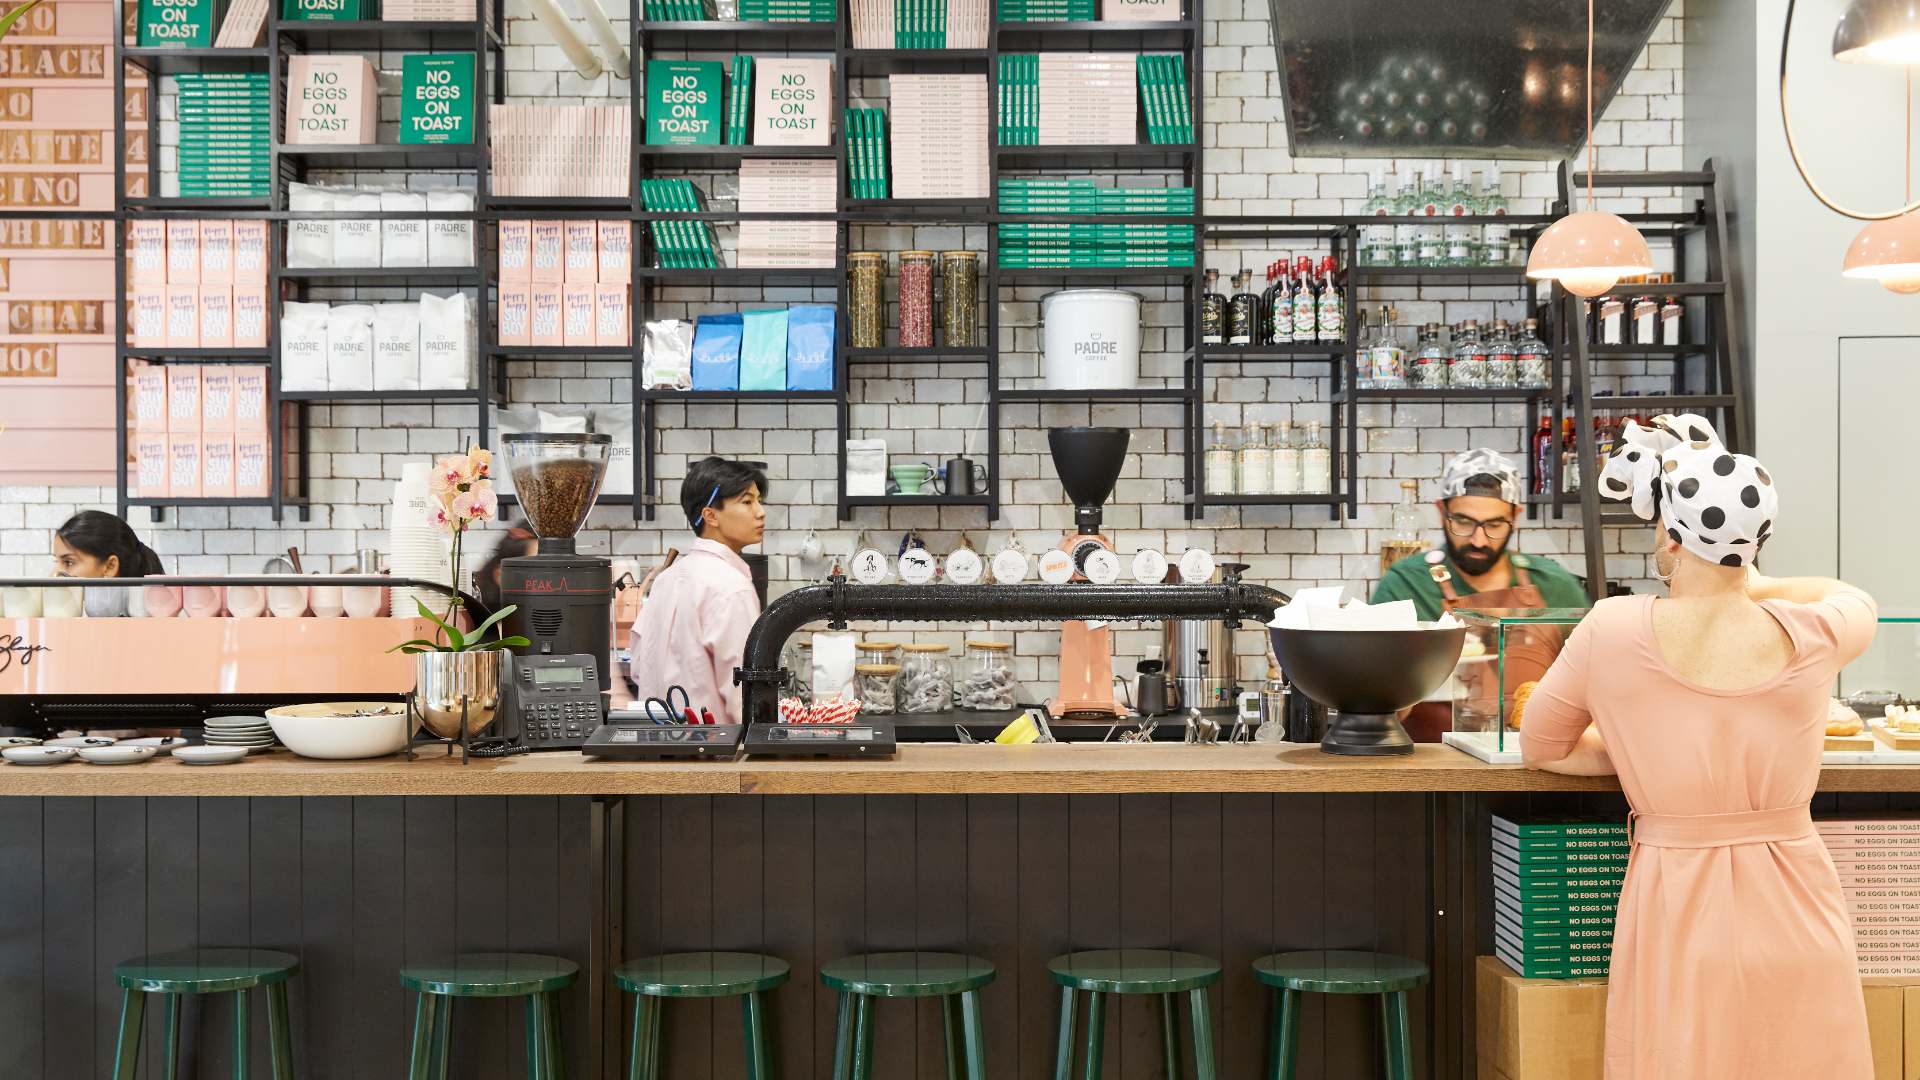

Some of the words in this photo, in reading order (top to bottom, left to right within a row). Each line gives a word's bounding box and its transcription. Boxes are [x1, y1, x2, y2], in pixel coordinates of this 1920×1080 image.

[162, 8, 187, 22] ON
[148, 23, 200, 38] TOAST
[314, 72, 338, 85] NO
[426, 70, 451, 84] NO
[672, 75, 698, 89] NO
[781, 74, 806, 86] NO
[303, 87, 348, 100] EGGS
[416, 85, 460, 100] EGGS
[662, 89, 707, 104] EGGS
[771, 88, 815, 101] EGGS
[0, 92, 31, 118] O
[125, 92, 144, 118] 4
[312, 103, 336, 115] ON
[425, 101, 450, 115] ON
[671, 104, 697, 118] ON
[780, 103, 805, 115] ON
[299, 118, 349, 131] TOAST
[412, 116, 462, 131] TOAST
[658, 119, 709, 133] TOAST
[768, 117, 818, 130] TOAST
[0, 135, 99, 161] ATTE
[127, 135, 146, 161] 4
[434, 223, 467, 233] PADRE
[10, 304, 97, 330] CHAI
[1074, 341, 1118, 354] PADRE
